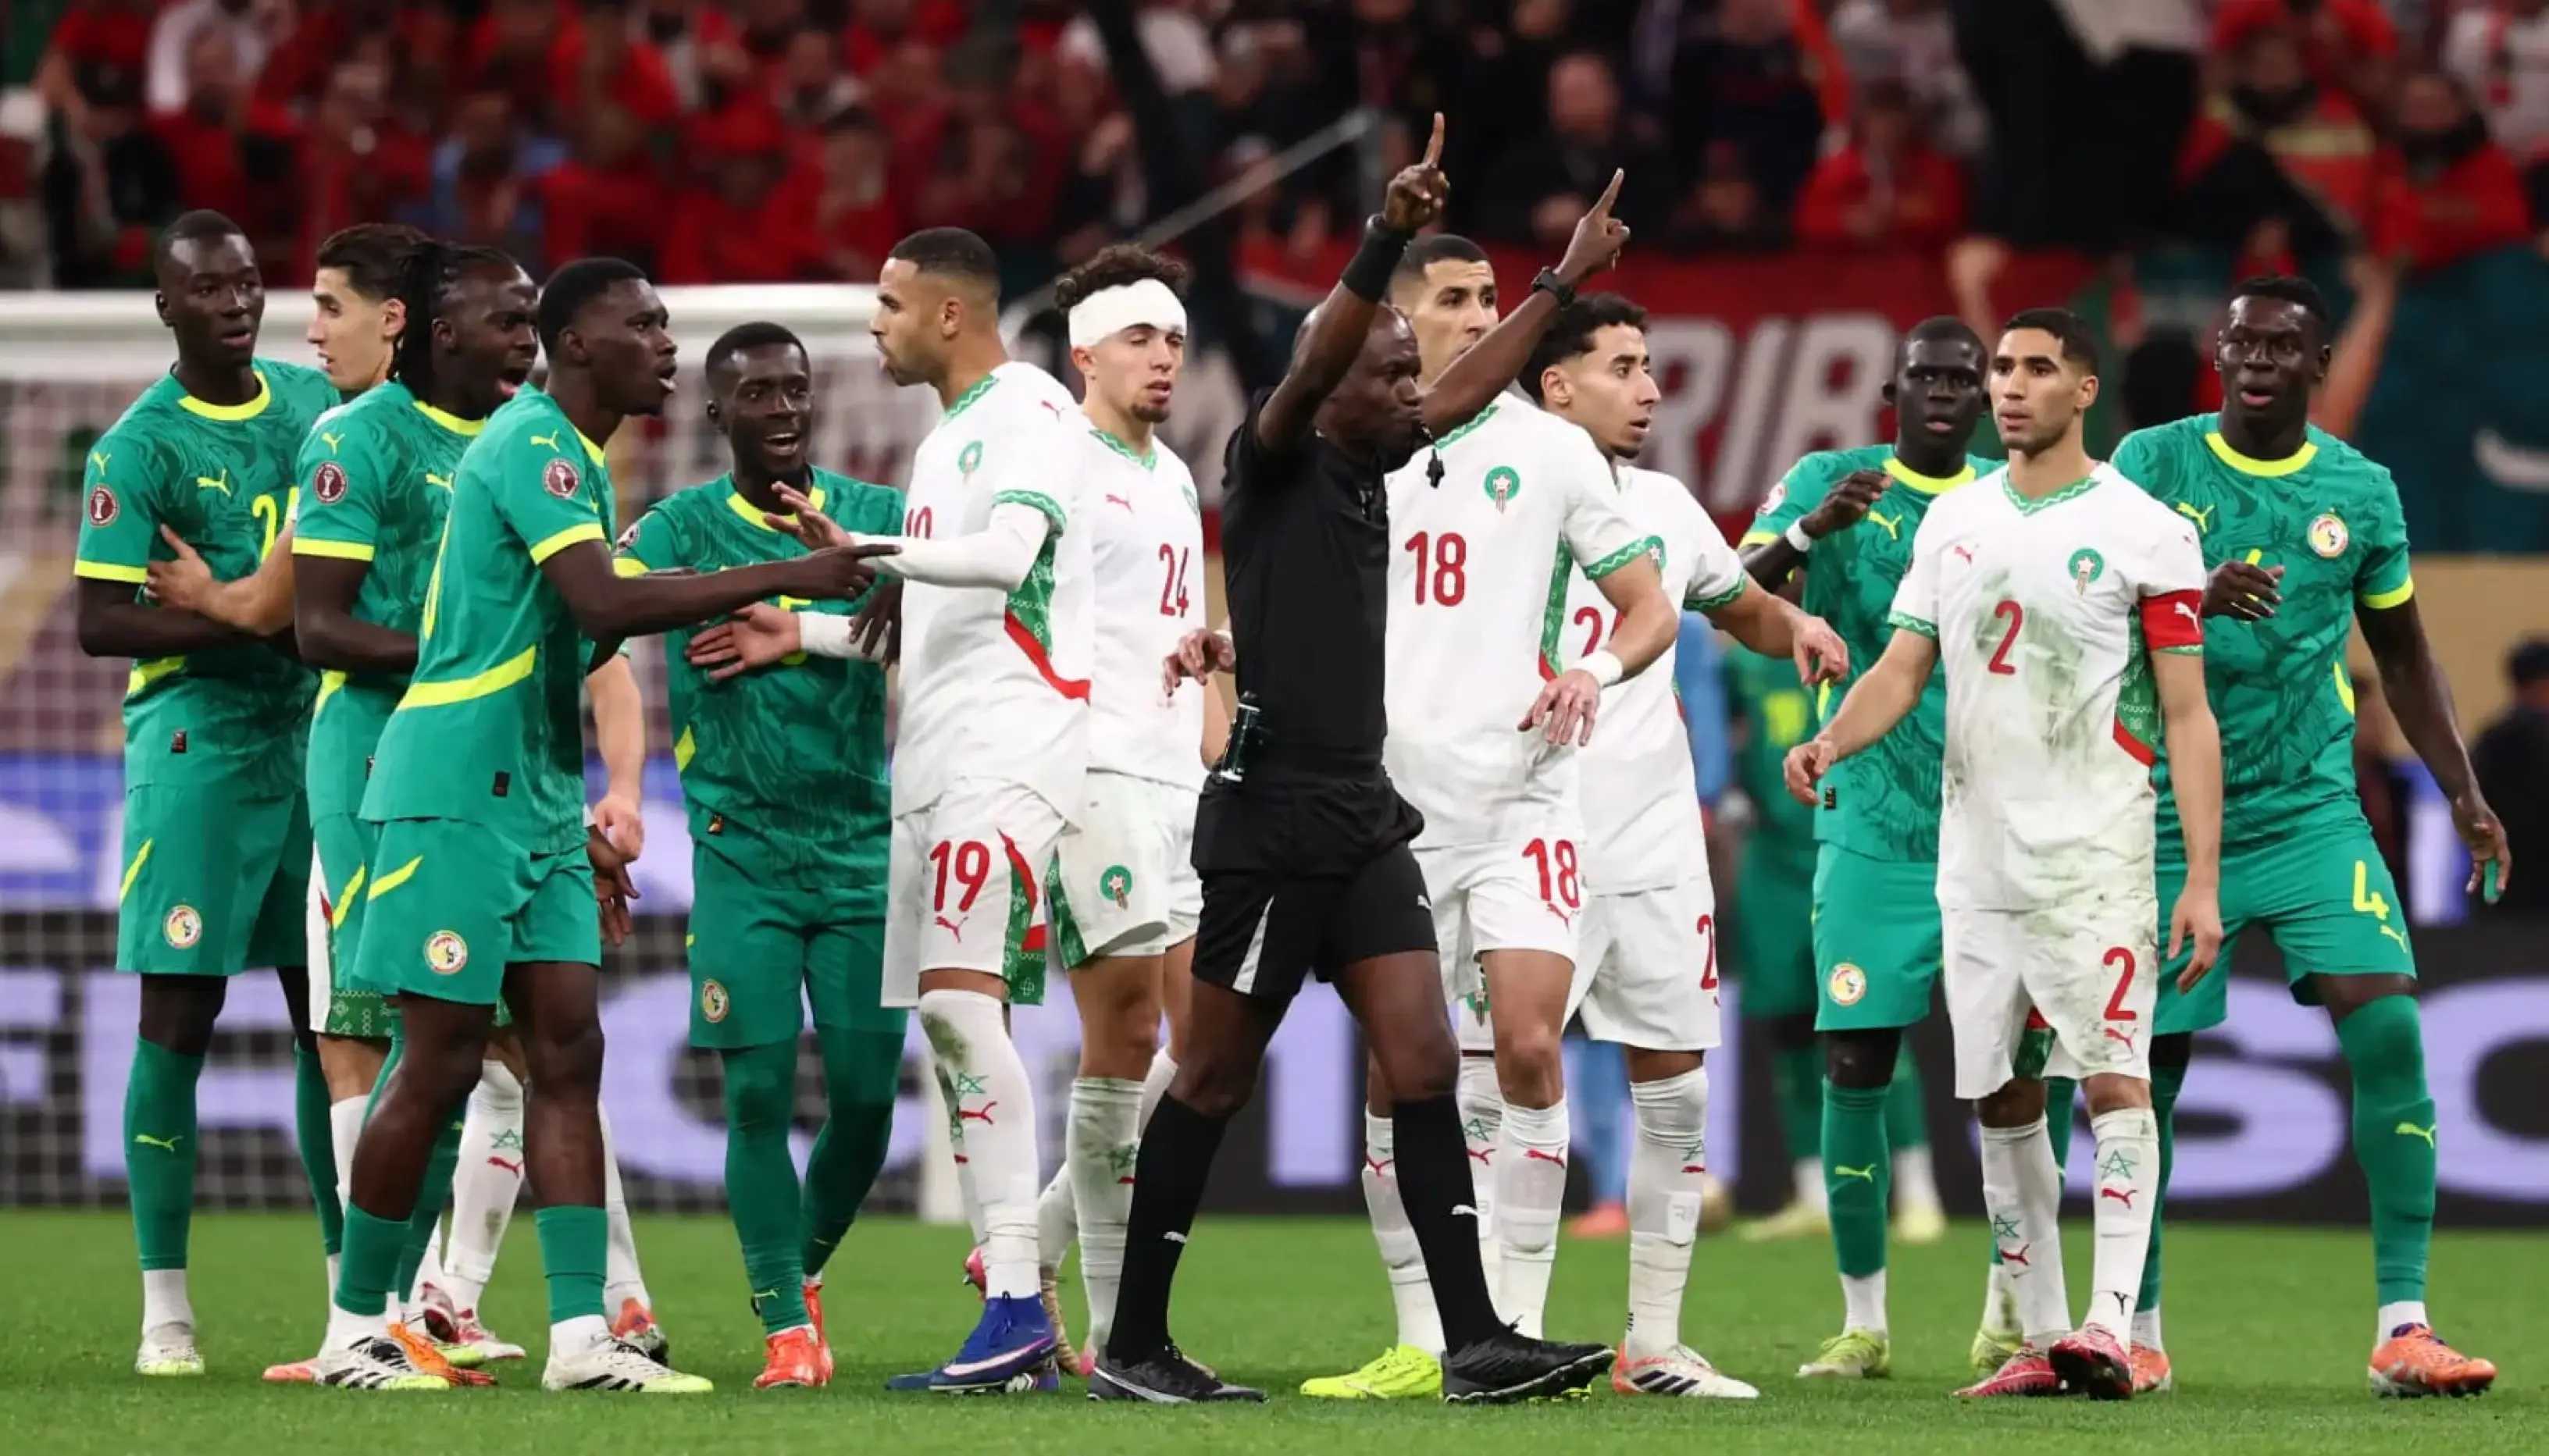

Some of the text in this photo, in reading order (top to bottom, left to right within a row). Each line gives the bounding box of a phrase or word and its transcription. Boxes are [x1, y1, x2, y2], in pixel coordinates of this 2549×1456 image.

[1159, 543, 1189, 618] 24
[1405, 531, 1466, 607] 18
[1988, 600, 2023, 676] 2
[929, 840, 990, 913] 19
[1522, 838, 1581, 908] 18
[2352, 860, 2390, 920] 4
[2103, 946, 2136, 1021] 2
